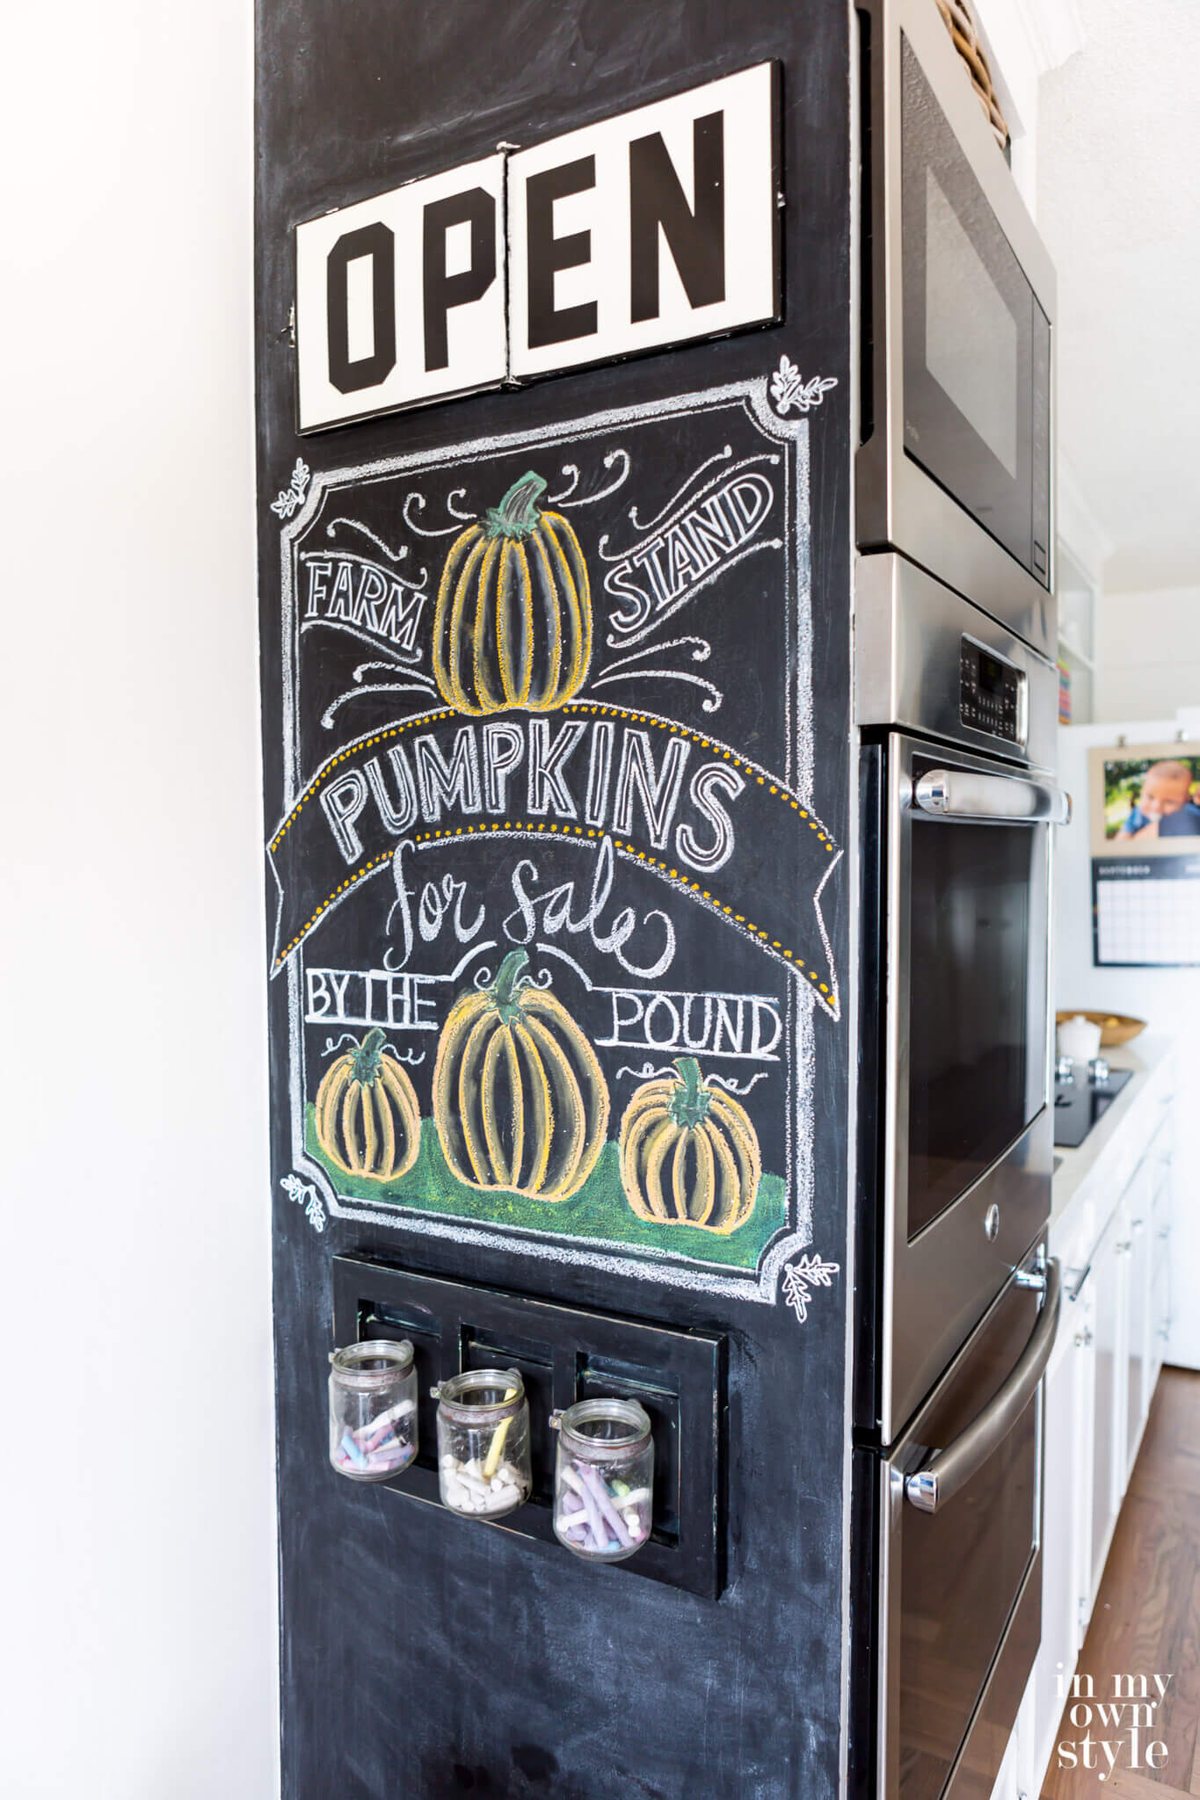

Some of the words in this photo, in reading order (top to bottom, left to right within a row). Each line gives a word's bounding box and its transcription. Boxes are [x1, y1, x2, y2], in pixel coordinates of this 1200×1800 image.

[327, 109, 726, 394] OPEN
[304, 561, 428, 651] FARM
[603, 473, 774, 633] STAND
[319, 718, 745, 873] PUMPKINS
[383, 840, 485, 971] for
[306, 969, 352, 1023] BY
[358, 969, 438, 1030] THE
[611, 990, 783, 1058] POUND
